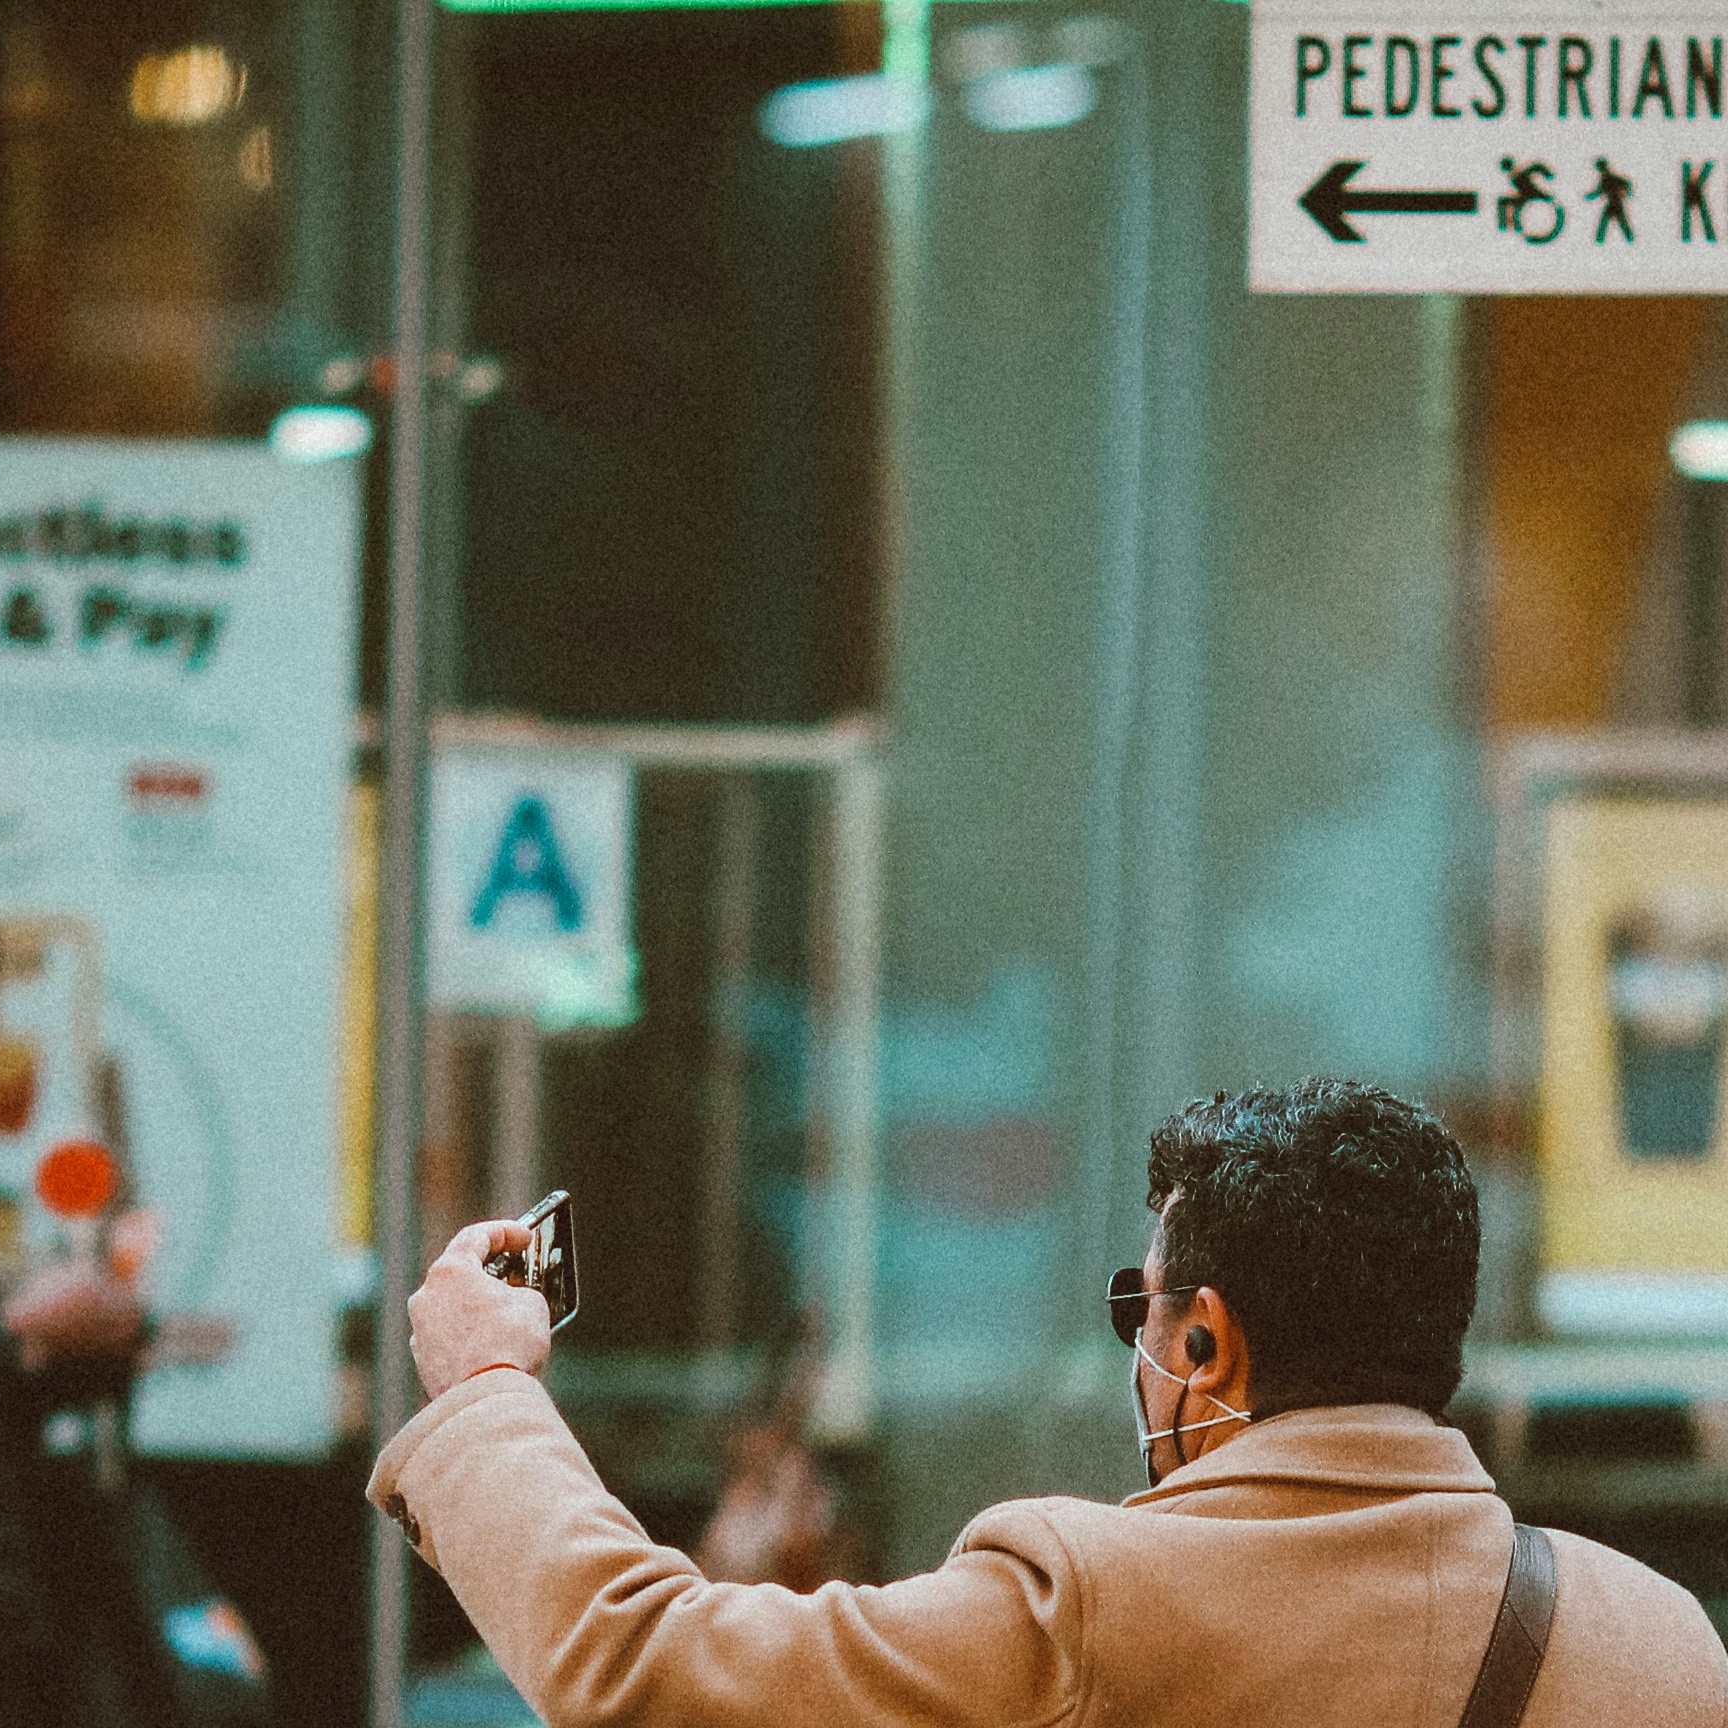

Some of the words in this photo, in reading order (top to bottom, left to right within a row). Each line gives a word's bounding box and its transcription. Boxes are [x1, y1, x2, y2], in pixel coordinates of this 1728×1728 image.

[1294, 34, 1723, 120] PEDESTRIAN
[75, 580, 225, 676] Pay
[468, 793, 585, 934] A
